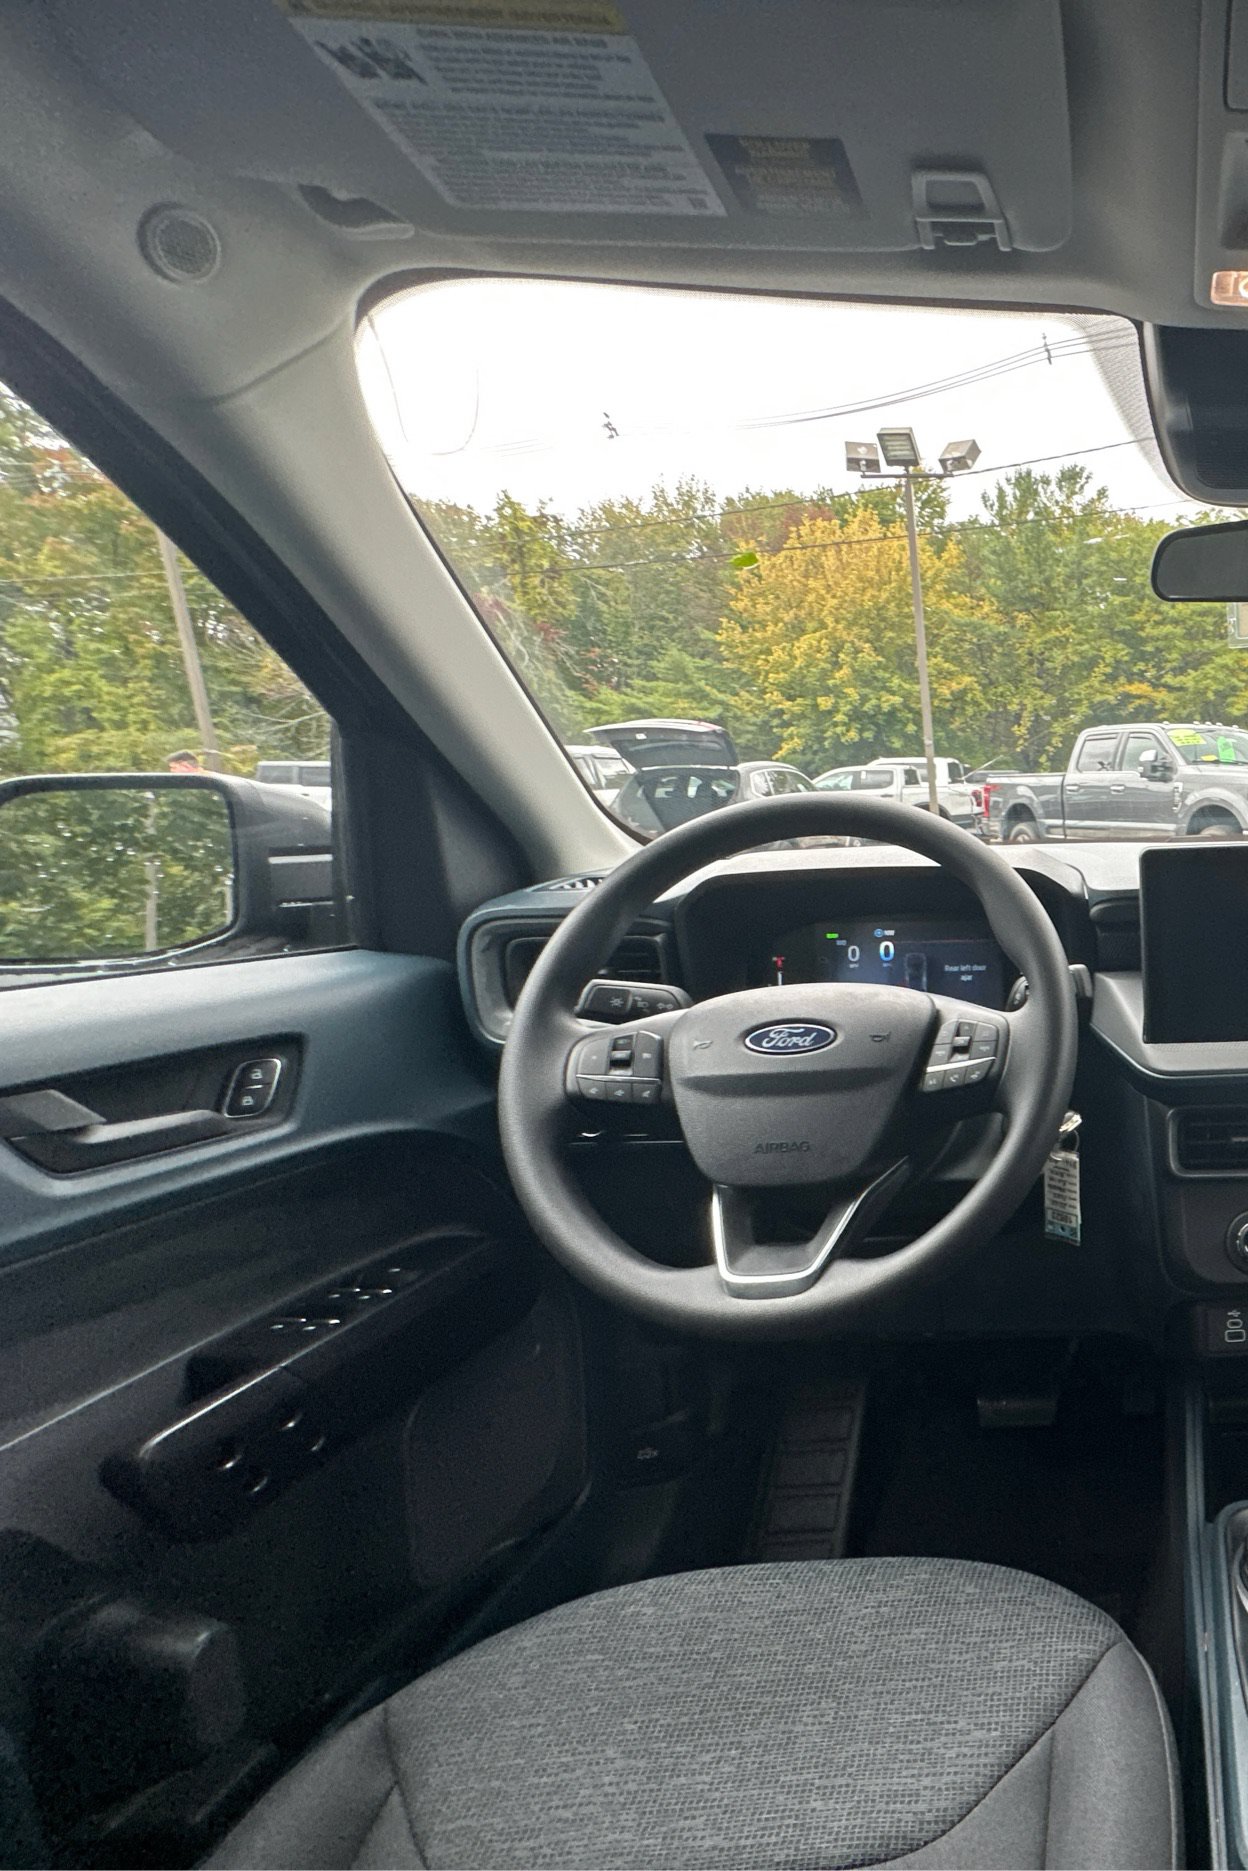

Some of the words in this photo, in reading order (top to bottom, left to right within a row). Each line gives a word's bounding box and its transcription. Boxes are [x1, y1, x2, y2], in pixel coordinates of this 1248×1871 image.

[847, 945, 860, 961] 0
[879, 940, 895, 961] 0
[960, 964, 971, 972] left
[762, 1028, 816, 1047] Ford
[753, 1141, 811, 1154] AIRBAG
